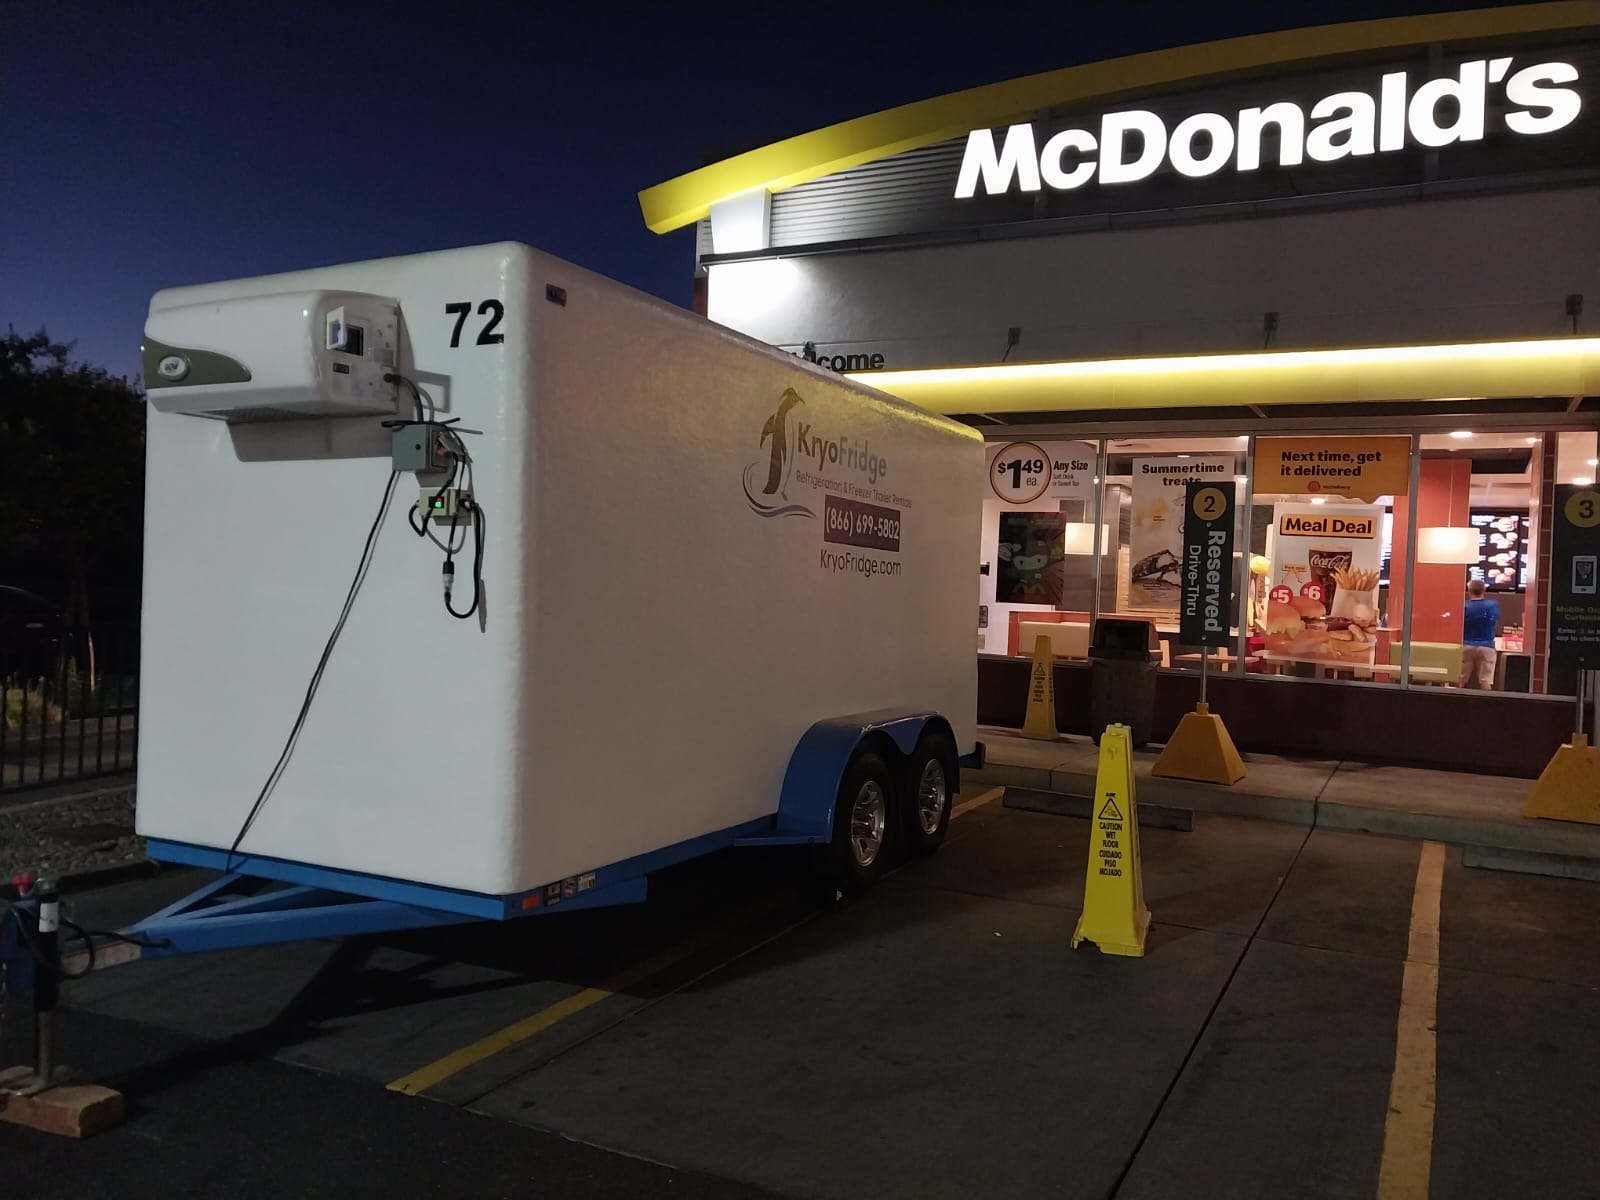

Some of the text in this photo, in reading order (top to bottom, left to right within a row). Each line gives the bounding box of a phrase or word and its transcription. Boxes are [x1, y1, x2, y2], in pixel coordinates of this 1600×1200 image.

[954, 57, 1581, 199] McDonald's
[446, 299, 505, 348] 72
[792, 350, 884, 371] lcome
[798, 422, 887, 484] KryoFridge
[1281, 450, 1381, 464] Next time, get
[1053, 459, 1088, 473] Any Size
[1142, 463, 1224, 474] Summertime
[1281, 465, 1361, 477] it delivered
[796, 470, 842, 492] Refrigeration
[849, 483, 872, 498] Freezer
[1203, 496, 1215, 512] 2
[1579, 500, 1594, 518] 3
[825, 506, 900, 540] (866) 699-5802
[1285, 518, 1372, 533] Meal Deal
[820, 549, 902, 577] KryoFridge.com
[1186, 545, 1202, 616] Drive-Thru
[1204, 531, 1227, 632] Reserved
[1272, 589, 1289, 604] $5
[1304, 585, 1321, 600] $6
[1099, 822, 1122, 831] CAUTION
[1102, 840, 1119, 848] FLOOR
[1099, 851, 1122, 859] CUIDADO
[1099, 869, 1122, 877] MOJADO
